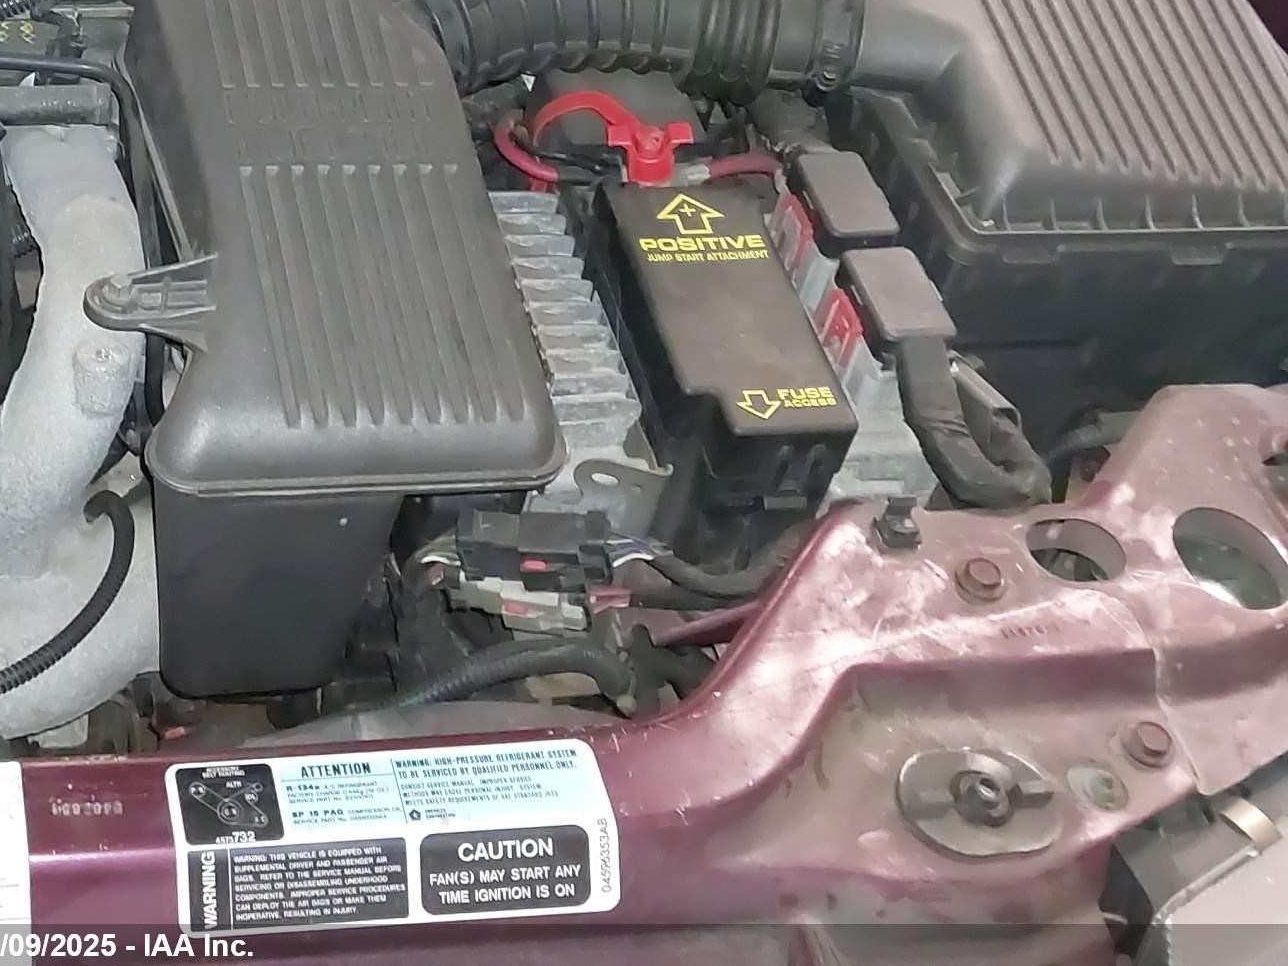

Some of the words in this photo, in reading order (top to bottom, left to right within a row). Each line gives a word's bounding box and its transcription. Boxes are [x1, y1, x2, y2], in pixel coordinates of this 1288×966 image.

[639, 235, 765, 252] POSITIVE
[647, 252, 672, 262] JUMP
[676, 251, 704, 262] START
[706, 250, 769, 261] ATTACHMENT
[776, 386, 834, 400] FUSE
[784, 399, 837, 408] ACCESS
[395, 759, 432, 768] WARNING:
[434, 754, 492, 766] HIGH-PRESSURE
[496, 751, 544, 762] REFRIGERANT
[548, 749, 577, 758] SYSTEM
[301, 762, 371, 778] ATTENTION
[398, 771, 408, 779] TO
[411, 770, 420, 778] BE
[423, 768, 457, 778] SERVICED
[460, 767, 469, 775] BY
[472, 764, 508, 775] QUALIFIED
[512, 761, 553, 772] PERSONNEL
[270, 853, 286, 861] THIS
[288, 851, 316, 860] VEHICLE
[328, 848, 362, 857] EQUIPPED
[363, 846, 382, 854] WITH
[457, 837, 554, 863] CAUTION
[234, 863, 286, 873] SUPPLEMENTAL
[289, 861, 313, 870] DRIVER
[316, 860, 330, 868] AND
[333, 857, 373, 866] PASSENGER
[260, 872, 283, 880] REFER
[298, 870, 310, 878] THE
[313, 868, 341, 877] SERVICE
[344, 866, 372, 875] MANUAL
[374, 865, 401, 873] BEFORE
[235, 883, 272, 892] SERVICING
[287, 878, 342, 889] DISASSEMBLING
[344, 875, 388, 885] UNDERHOOD
[429, 871, 475, 887] FAN(S)
[479, 869, 505, 883] MAY
[511, 866, 550, 881] START
[555, 864, 581, 878] ANY
[201, 851, 217, 929] WARNING
[291, 889, 325, 898] IMPROPER
[328, 886, 357, 895] SERVICE
[359, 883, 406, 894] PROCEDURES
[438, 890, 470, 904] TIME
[475, 886, 531, 903] IGNITION
[536, 885, 550, 898] IS
[555, 883, 575, 897] ON
[235, 903, 251, 911] CAN
[252, 901, 279, 910] DEPLOY
[282, 900, 295, 908] THE
[345, 896, 365, 904] MAKE
[367, 894, 386, 903] THEM
[283, 908, 321, 918] RESULTING
